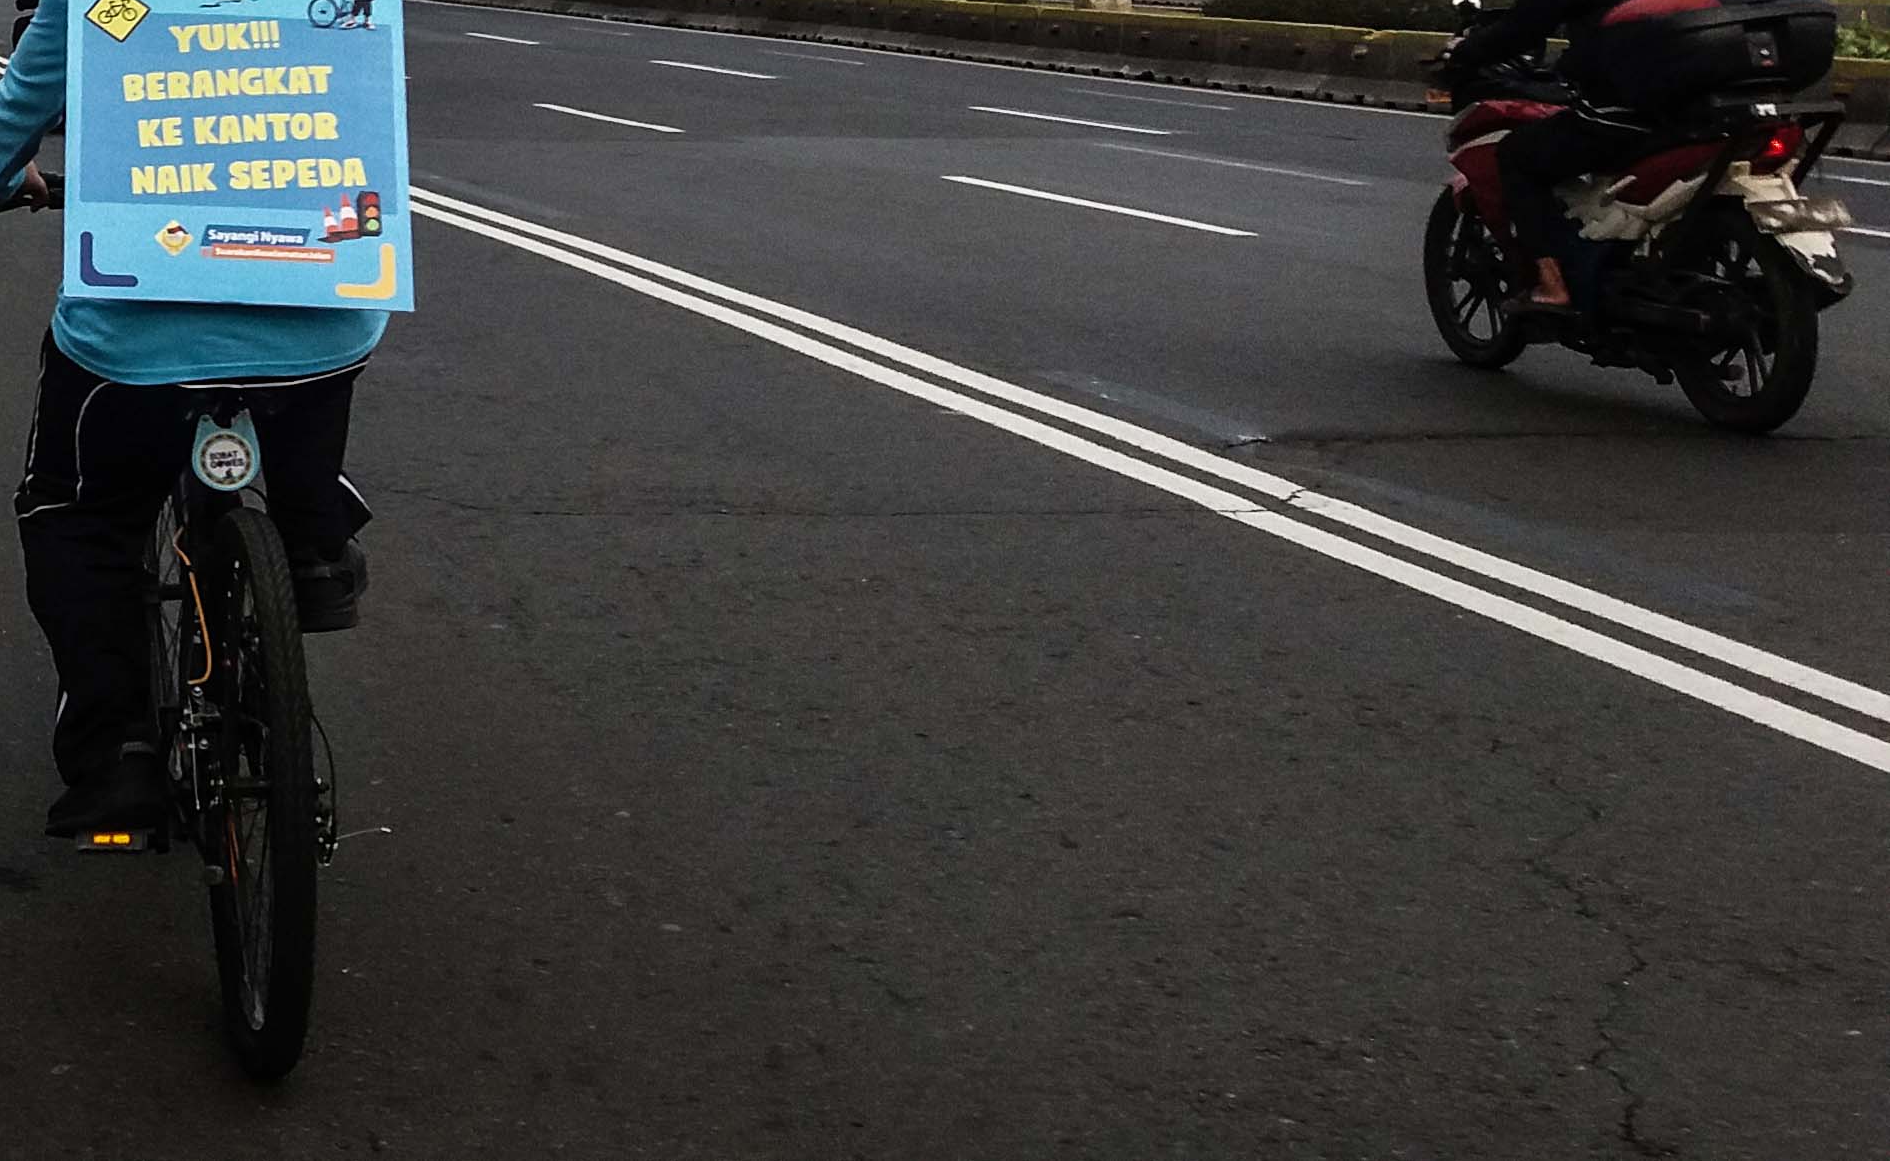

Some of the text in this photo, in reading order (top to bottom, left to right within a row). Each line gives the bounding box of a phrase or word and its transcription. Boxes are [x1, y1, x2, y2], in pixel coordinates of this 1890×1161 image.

[168, 20, 280, 54] YUK!!!
[122, 65, 333, 102] BERANGKAT
[137, 111, 340, 148] KE KANTOR
[130, 157, 368, 195] NAIK SEPEDA
[207, 229, 304, 245] Sayangi Nyawa
